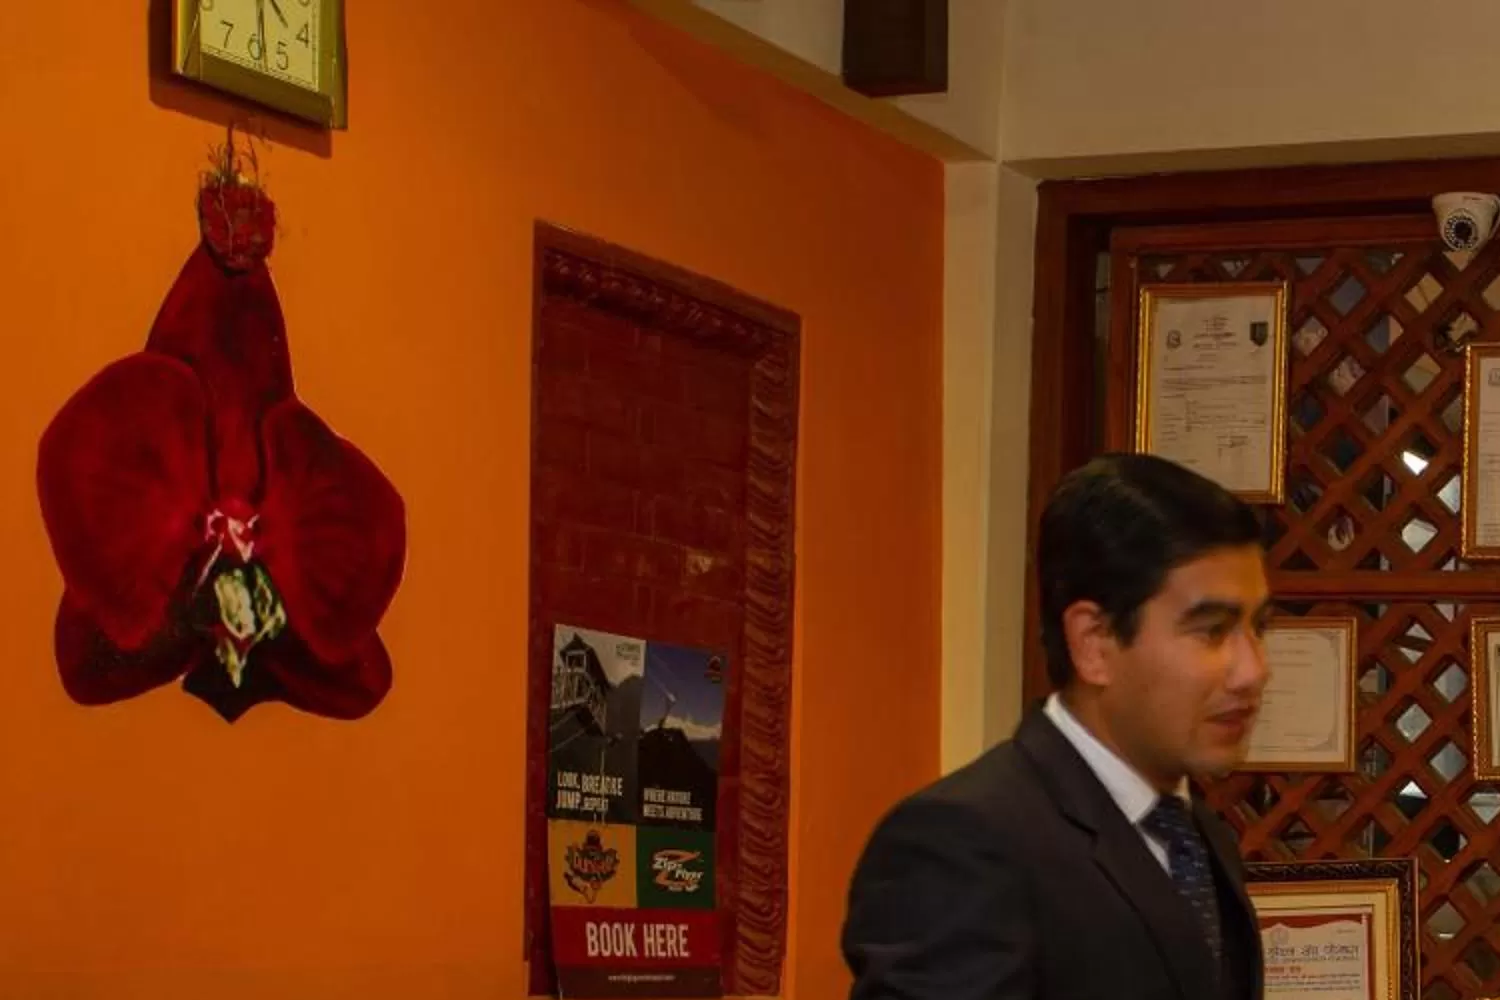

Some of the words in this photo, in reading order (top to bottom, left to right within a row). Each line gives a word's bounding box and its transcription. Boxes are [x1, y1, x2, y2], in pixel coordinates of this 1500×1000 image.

[219, 19, 235, 49] 7
[296, 23, 310, 48] 4
[276, 40, 290, 71] 5
[585, 921, 639, 958] BOOK
[642, 922, 691, 958] HERE
